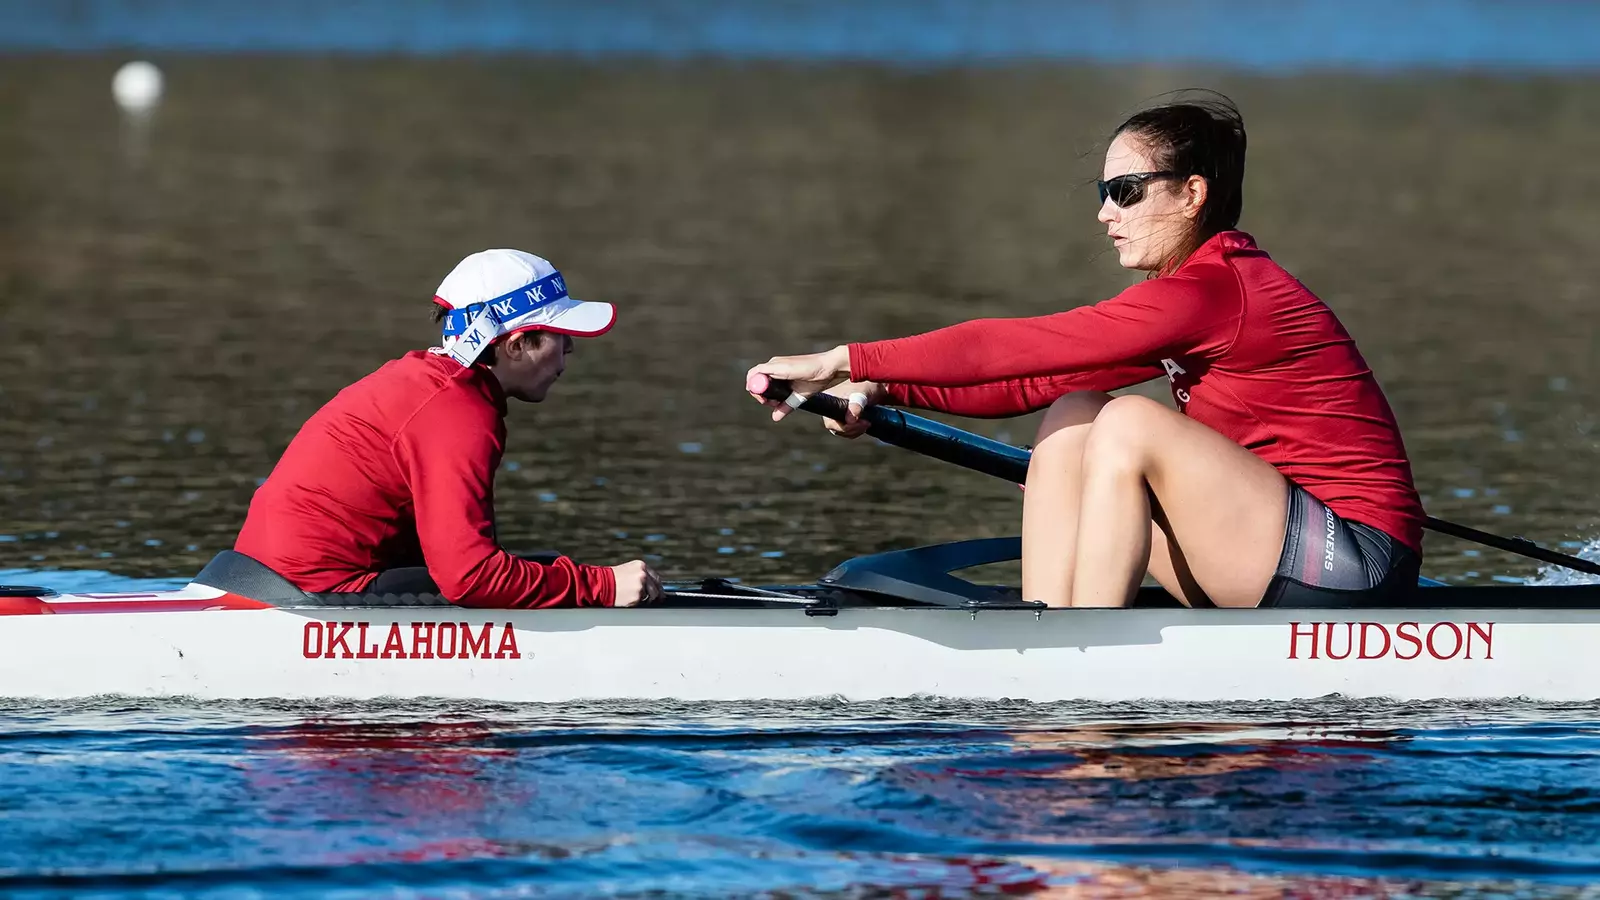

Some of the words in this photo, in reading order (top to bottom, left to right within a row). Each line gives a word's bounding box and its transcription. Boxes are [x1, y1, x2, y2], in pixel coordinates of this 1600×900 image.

[491, 297, 518, 318] NK
[524, 285, 547, 306] NK
[1324, 506, 1335, 571] SOONERS
[302, 621, 521, 660] OKLAHOMA
[1286, 621, 1496, 660] HUDSON
